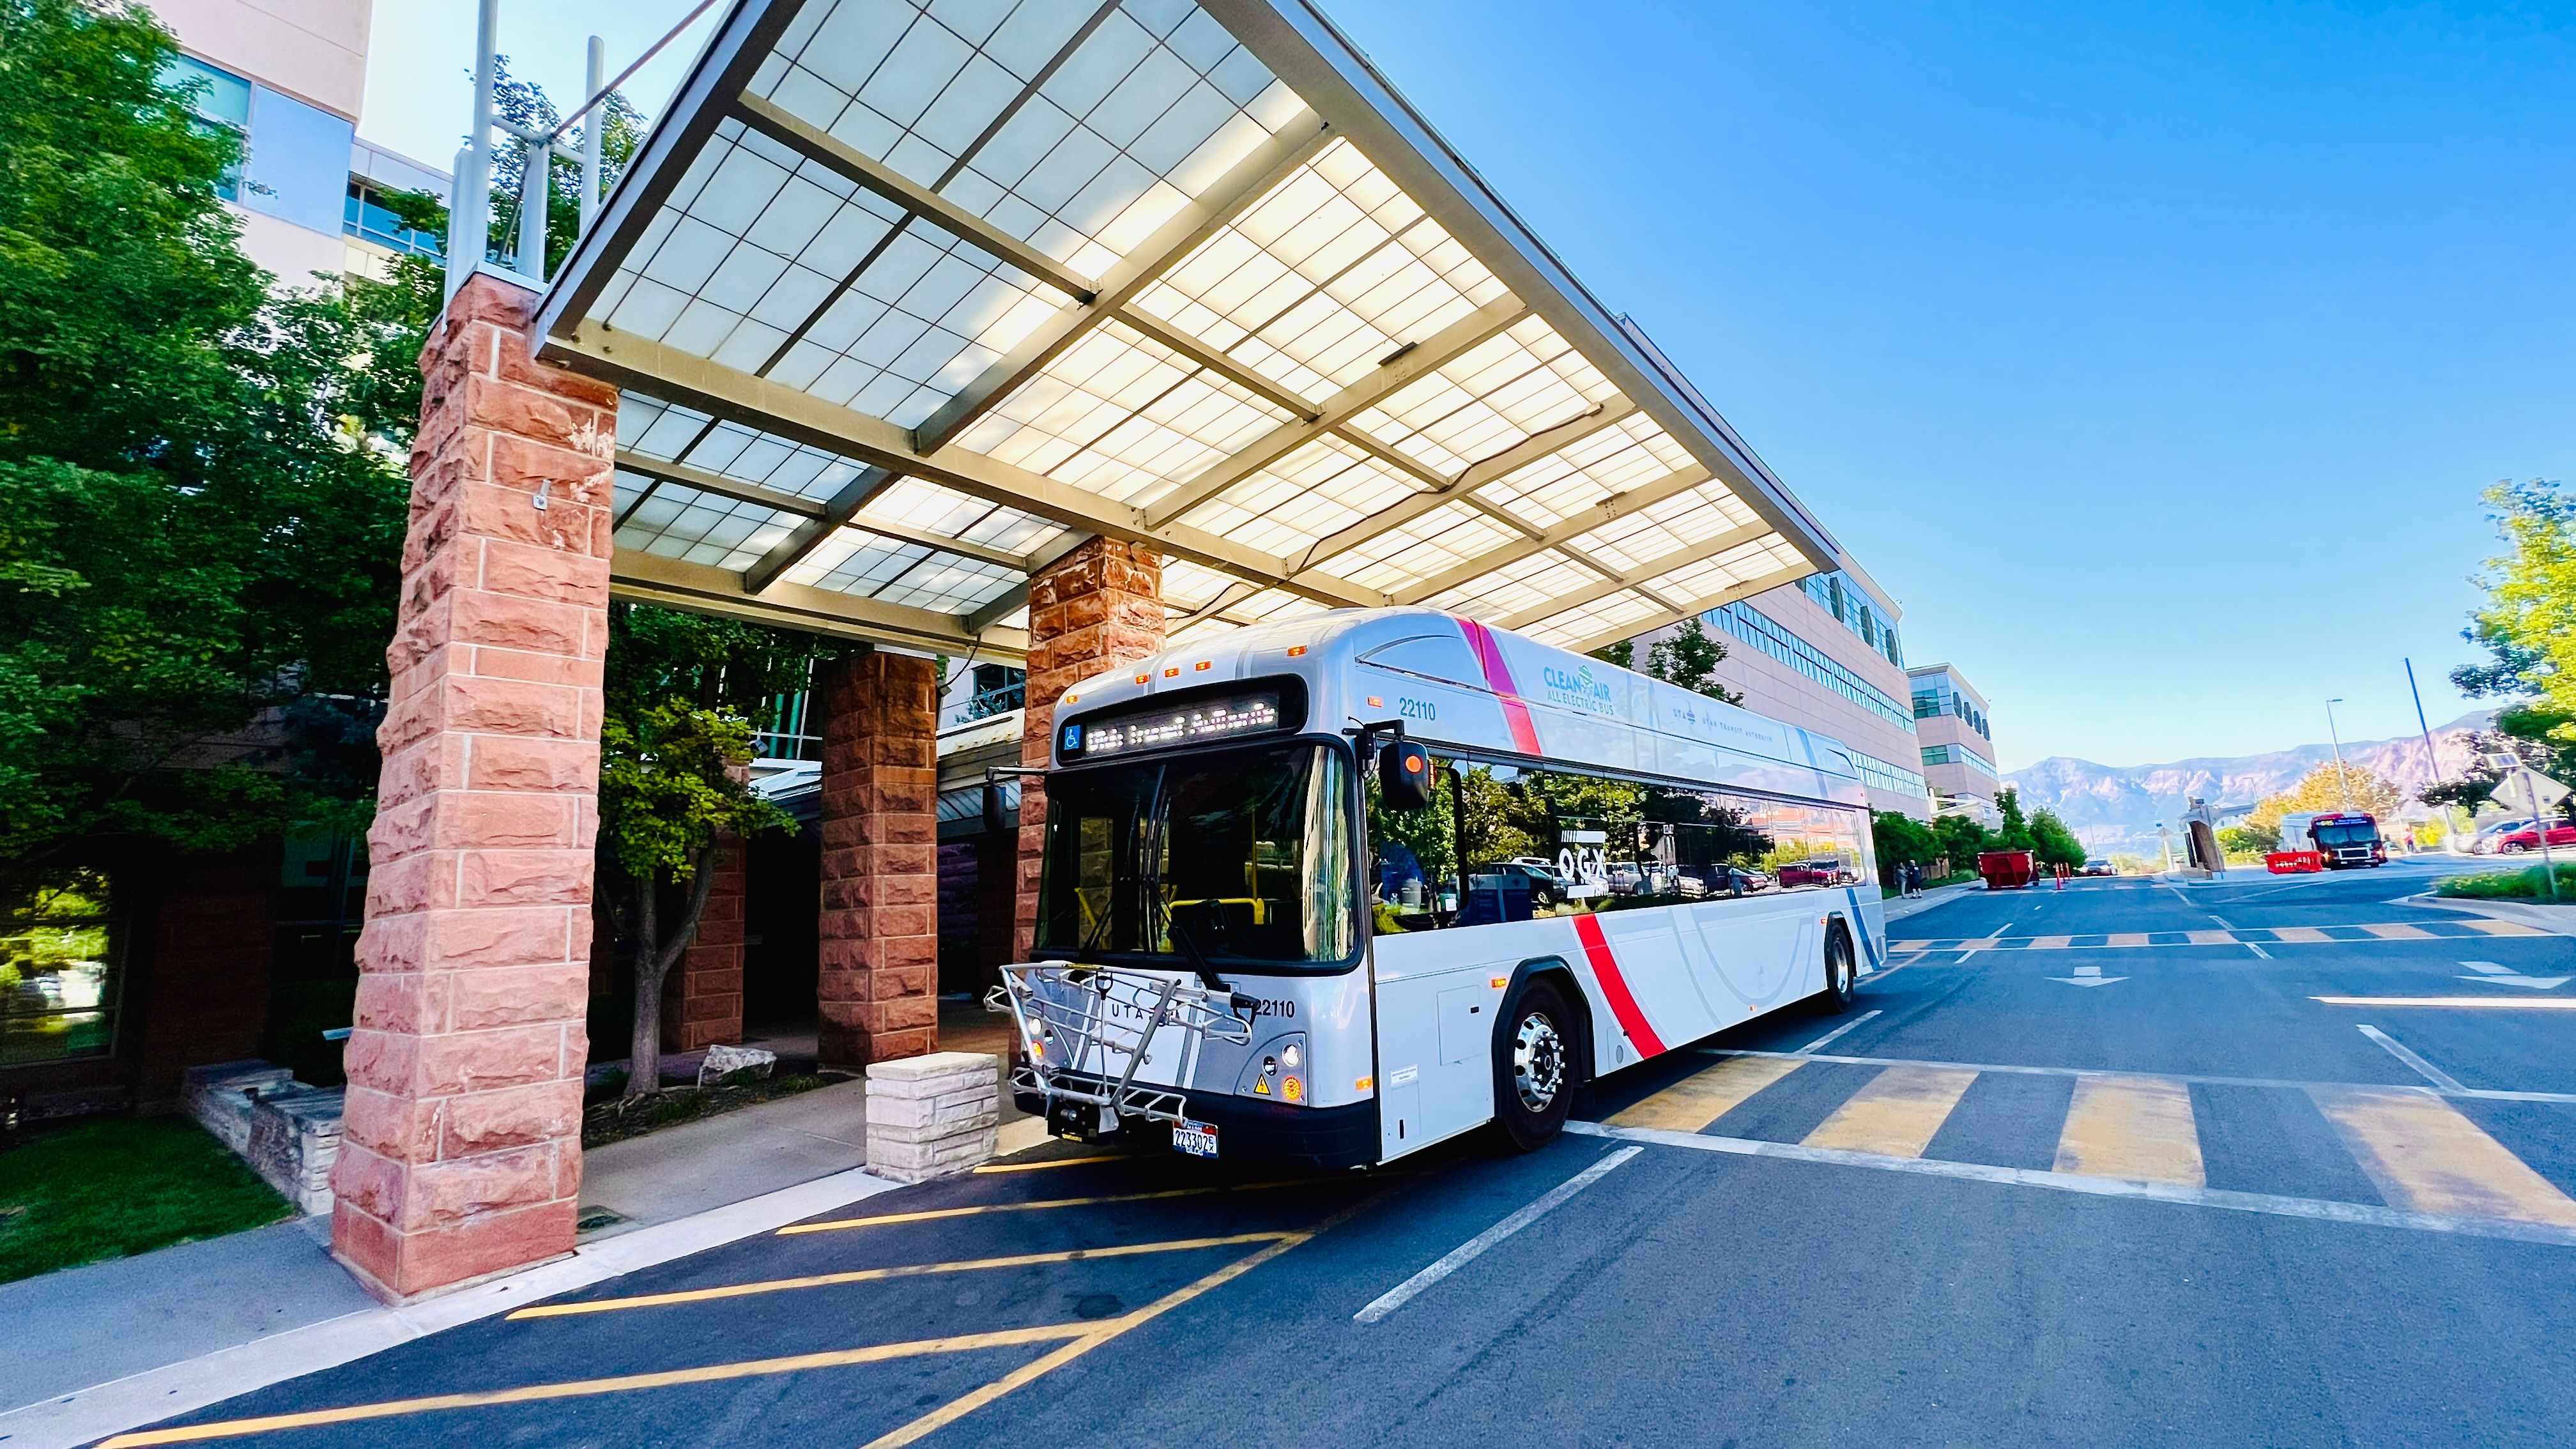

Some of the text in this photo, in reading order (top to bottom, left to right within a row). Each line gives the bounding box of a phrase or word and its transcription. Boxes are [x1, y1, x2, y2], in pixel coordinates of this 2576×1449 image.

[1544, 666, 1612, 702] CLEAN AIR
[1399, 697, 1436, 721] 22110
[1547, 690, 1614, 716] ALL ELECTRIC BUS
[1673, 709, 1686, 719] UTA
[1559, 848, 1608, 880] OGX
[1112, 1003, 1144, 1020] UTA
